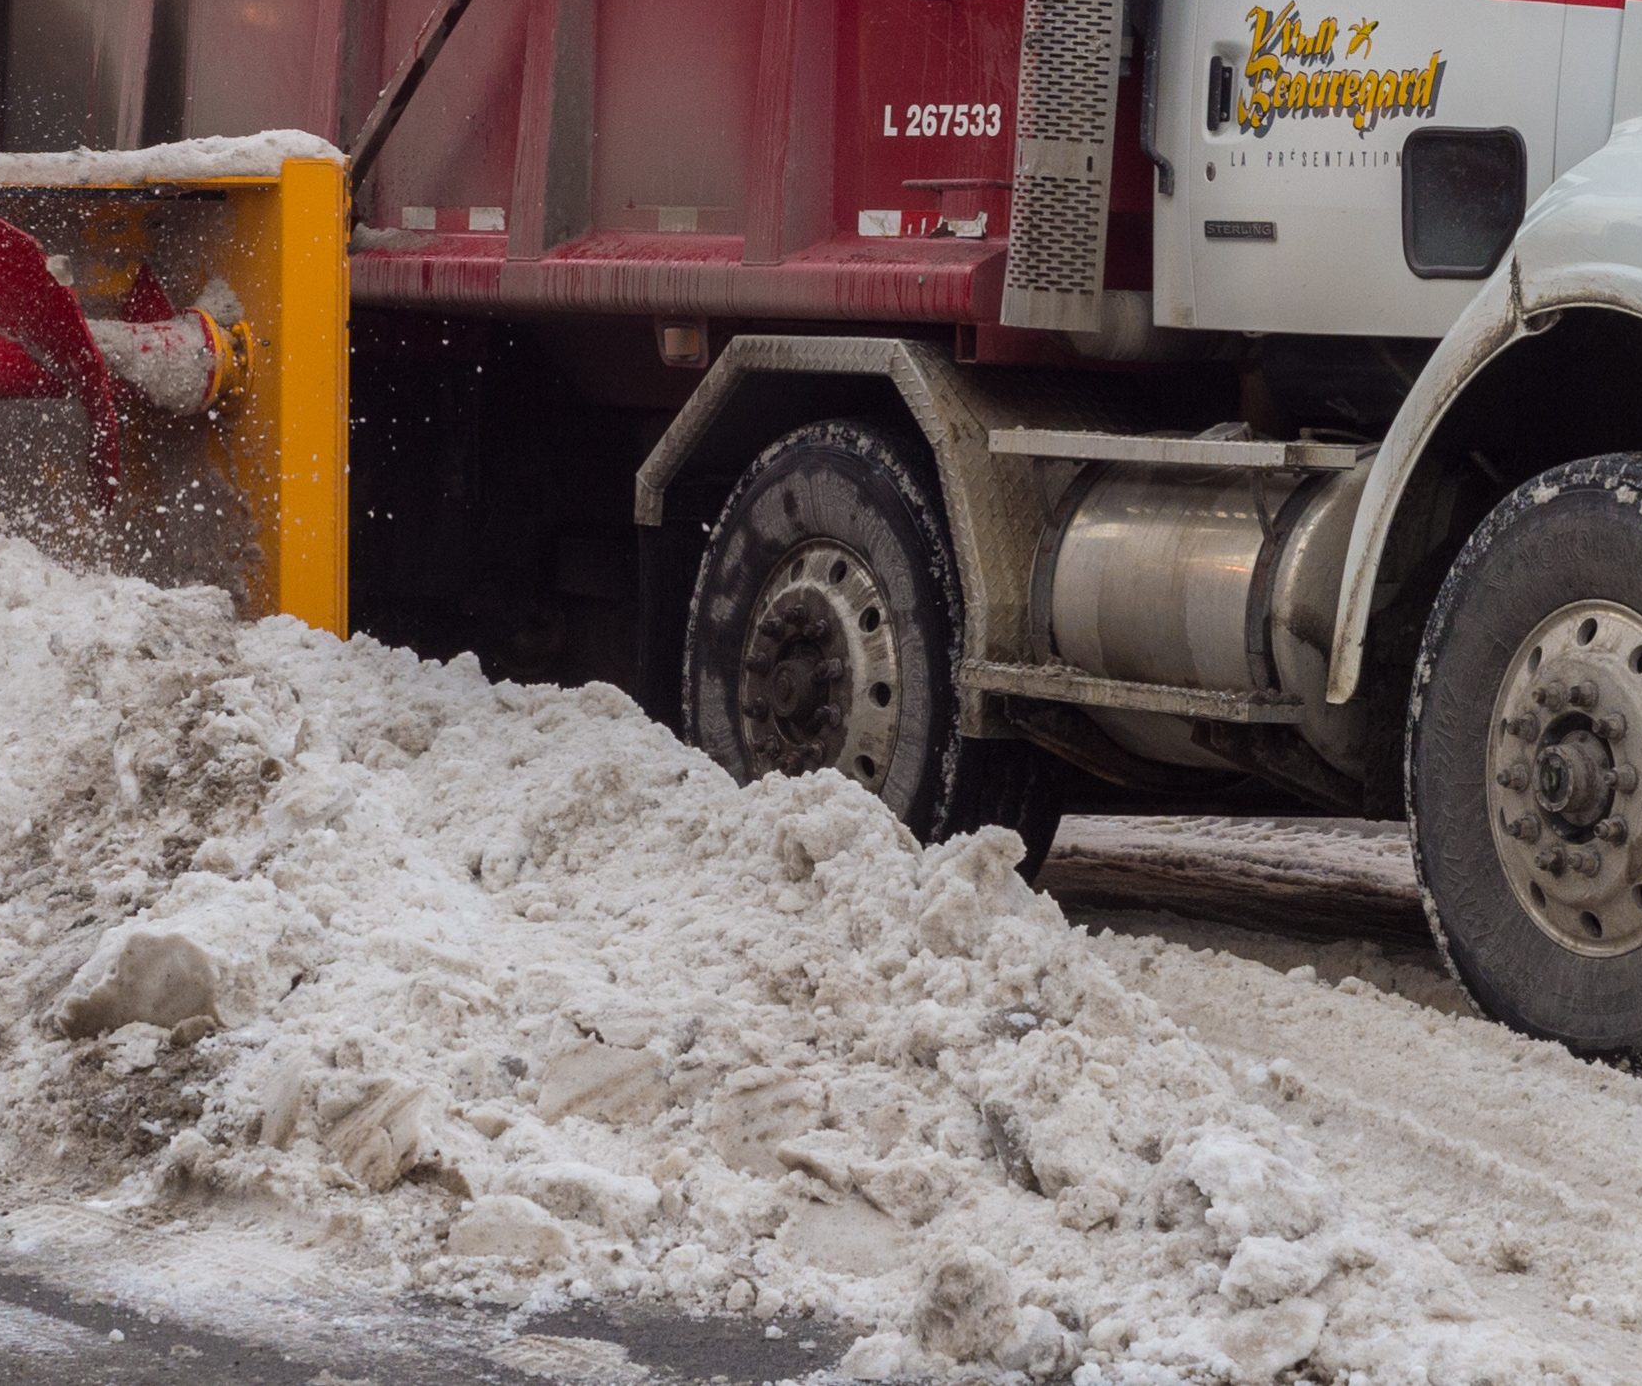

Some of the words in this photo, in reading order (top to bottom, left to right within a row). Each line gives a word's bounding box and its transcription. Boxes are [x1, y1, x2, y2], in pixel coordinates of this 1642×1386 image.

[1237, 48, 1447, 140] Beauregard
[883, 105, 898, 136] L
[905, 103, 1002, 137] 267533
[1230, 151, 1247, 167] LA
[1207, 222, 1272, 236] STERLING
